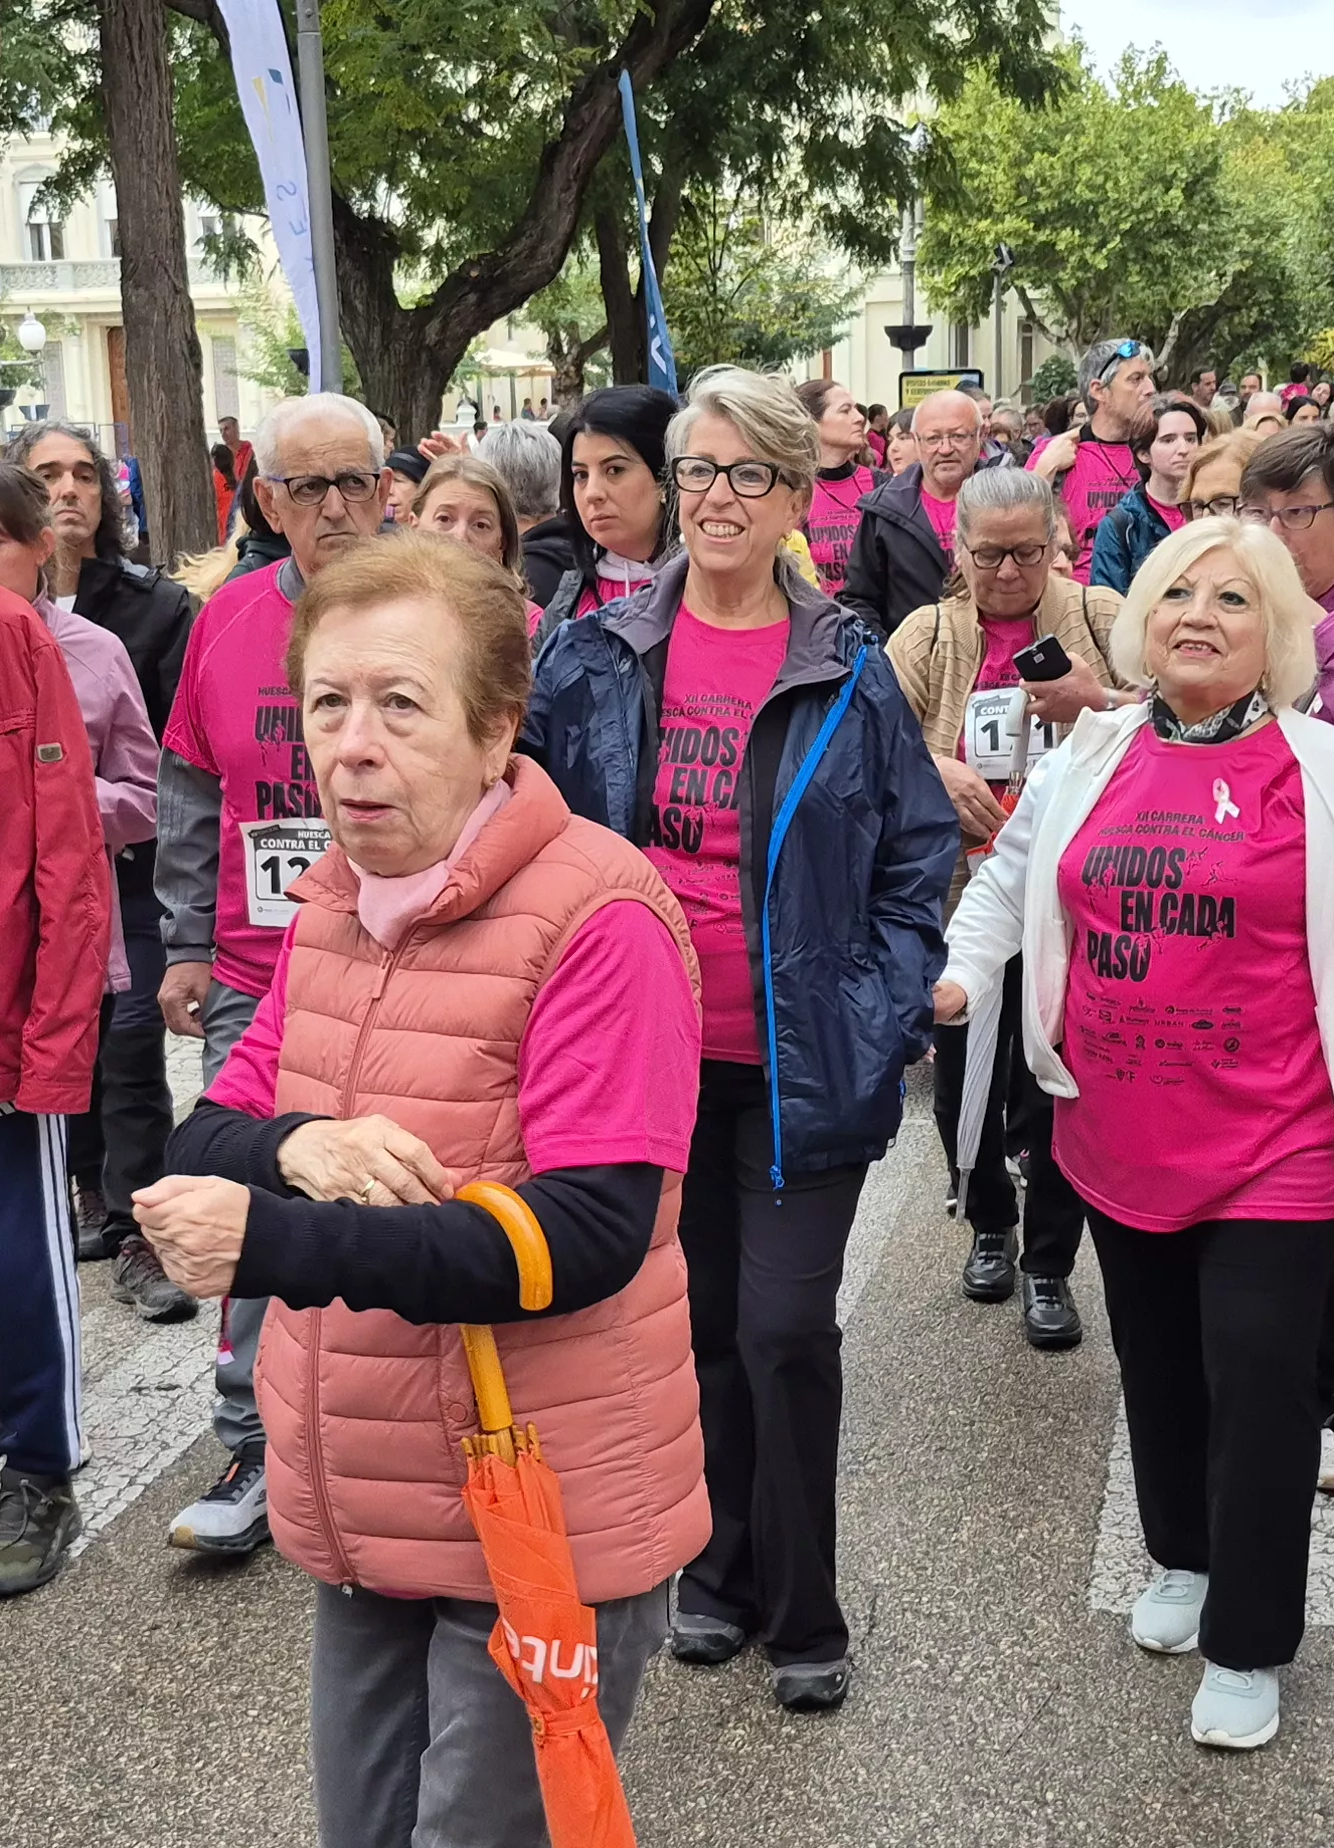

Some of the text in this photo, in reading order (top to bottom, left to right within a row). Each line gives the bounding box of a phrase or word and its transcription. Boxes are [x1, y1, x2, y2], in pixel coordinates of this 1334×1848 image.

[700, 694, 752, 710] CARRERA
[687, 706, 731, 718] CONTRA
[733, 709, 747, 719] EL
[669, 767, 707, 806] EN
[1148, 811, 1205, 825] CARRERA
[297, 830, 331, 841] HUESCA
[1135, 825, 1181, 836] CONTRA
[1182, 827, 1196, 837] EL
[1199, 828, 1244, 843] CÁNCER
[260, 838, 306, 850] CONTRA
[308, 840, 320, 850] EL
[1082, 845, 1186, 890] UNIDOS
[1121, 890, 1237, 939] EN CADA
[1087, 930, 1152, 983] PASO
